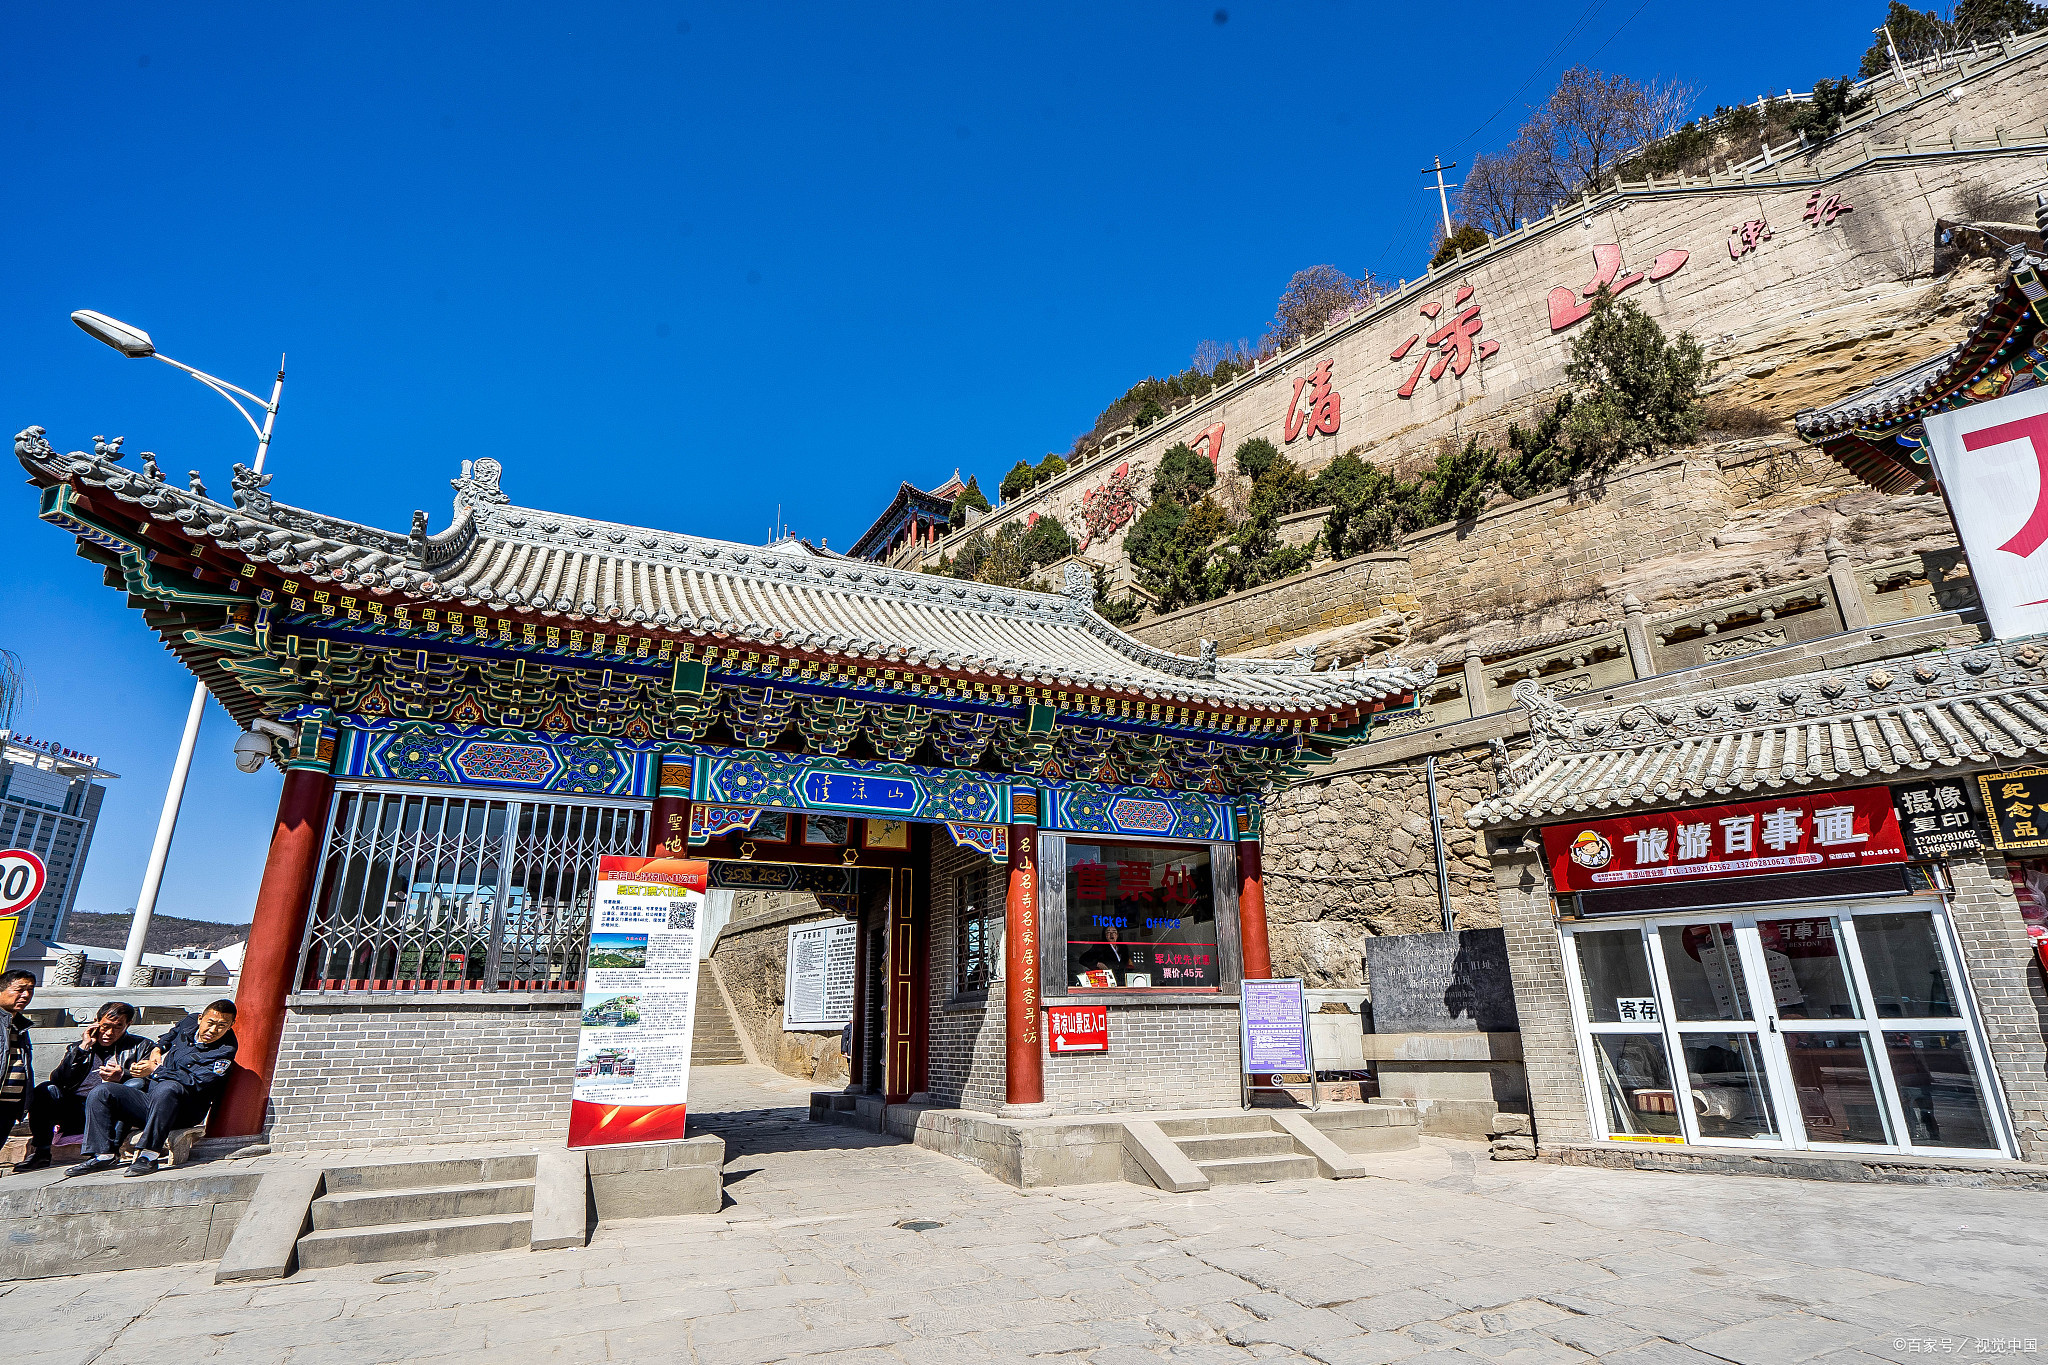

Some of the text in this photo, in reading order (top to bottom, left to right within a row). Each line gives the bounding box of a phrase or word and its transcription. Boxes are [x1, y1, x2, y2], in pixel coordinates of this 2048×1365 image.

[1901, 785, 1966, 815] 摄像
[2001, 782, 2039, 838] 纪念品
[1909, 811, 1970, 834] 复印
[1623, 805, 1869, 865] 旅游百事通
[1917, 838, 1981, 855] 13468597485
[1736, 858, 1786, 869] 13209281062
[1788, 855, 1818, 864] 微信同号
[617, 884, 688, 897] 景区门票大优惠
[1071, 858, 1197, 905] 售票处
[1091, 915, 1181, 929] Ticket Office
[1154, 953, 1211, 966] 军人优先优惠
[1620, 1000, 1656, 1020] 寄存
[1051, 1012, 1106, 1035] 清凉山景区入口
